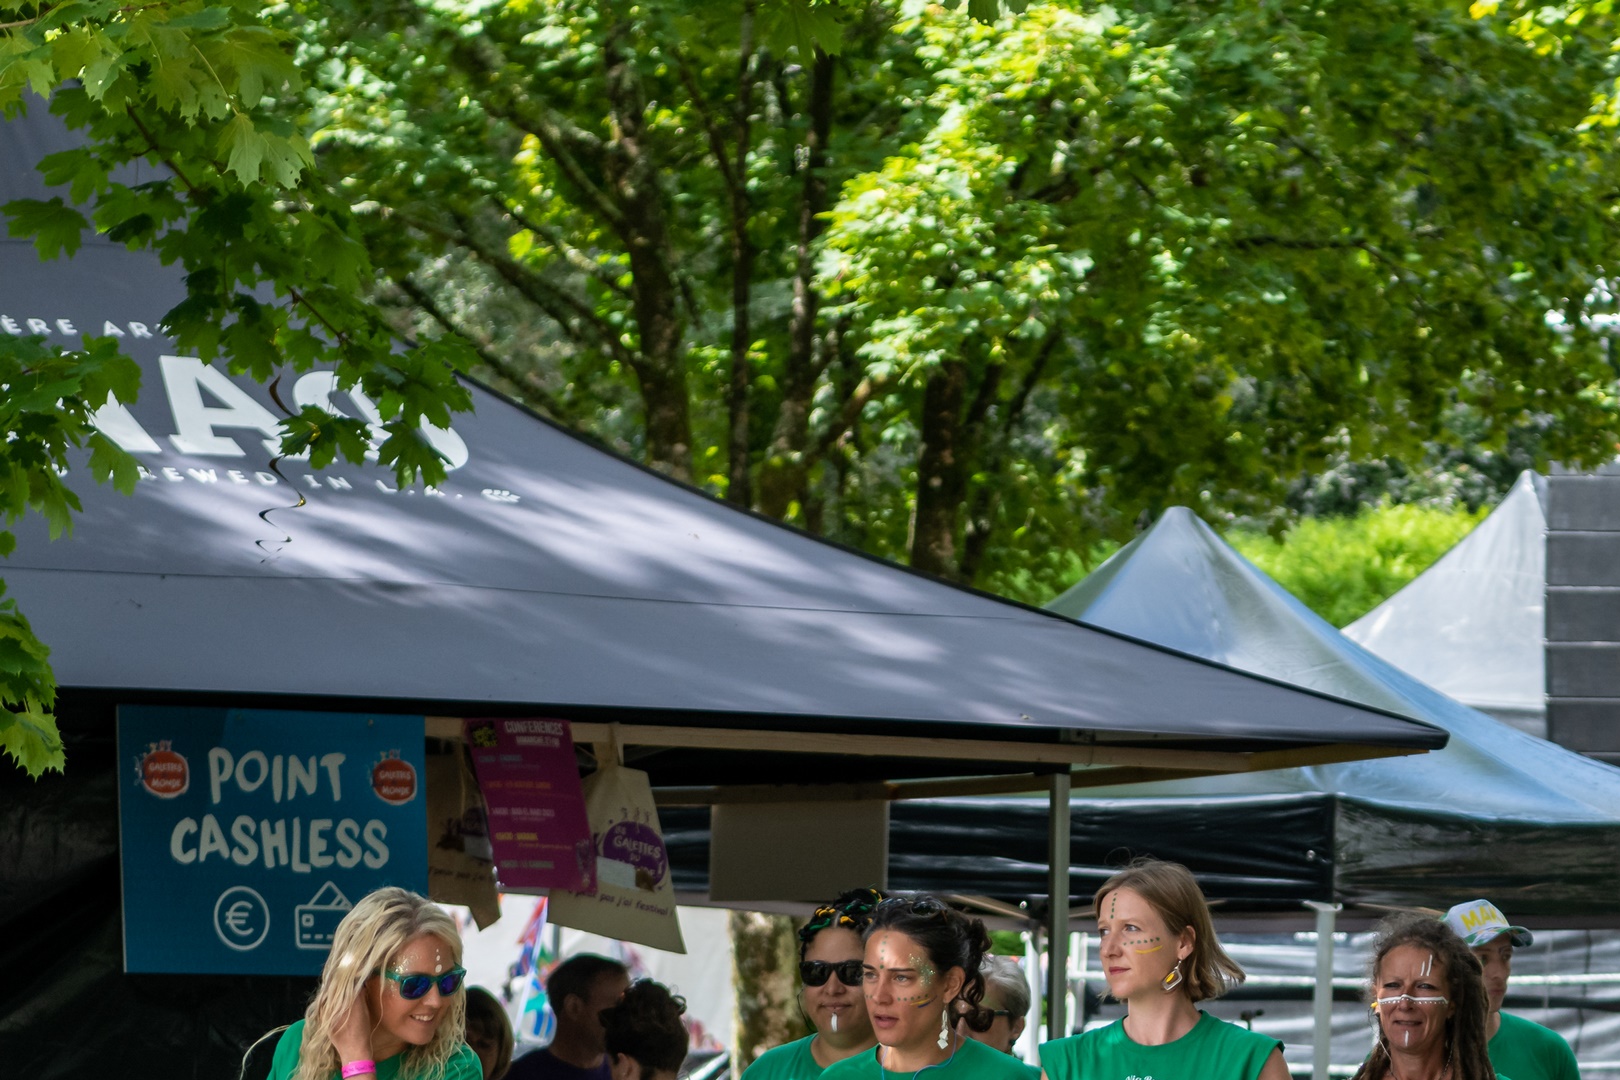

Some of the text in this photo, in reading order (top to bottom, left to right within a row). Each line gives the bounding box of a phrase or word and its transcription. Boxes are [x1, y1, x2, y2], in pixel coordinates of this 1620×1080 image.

[303, 474, 353, 490] IN
[208, 747, 346, 805] POINT
[170, 813, 389, 873] CASHLESS
[613, 834, 661, 859] GALETTES
[635, 899, 668, 916] festival
